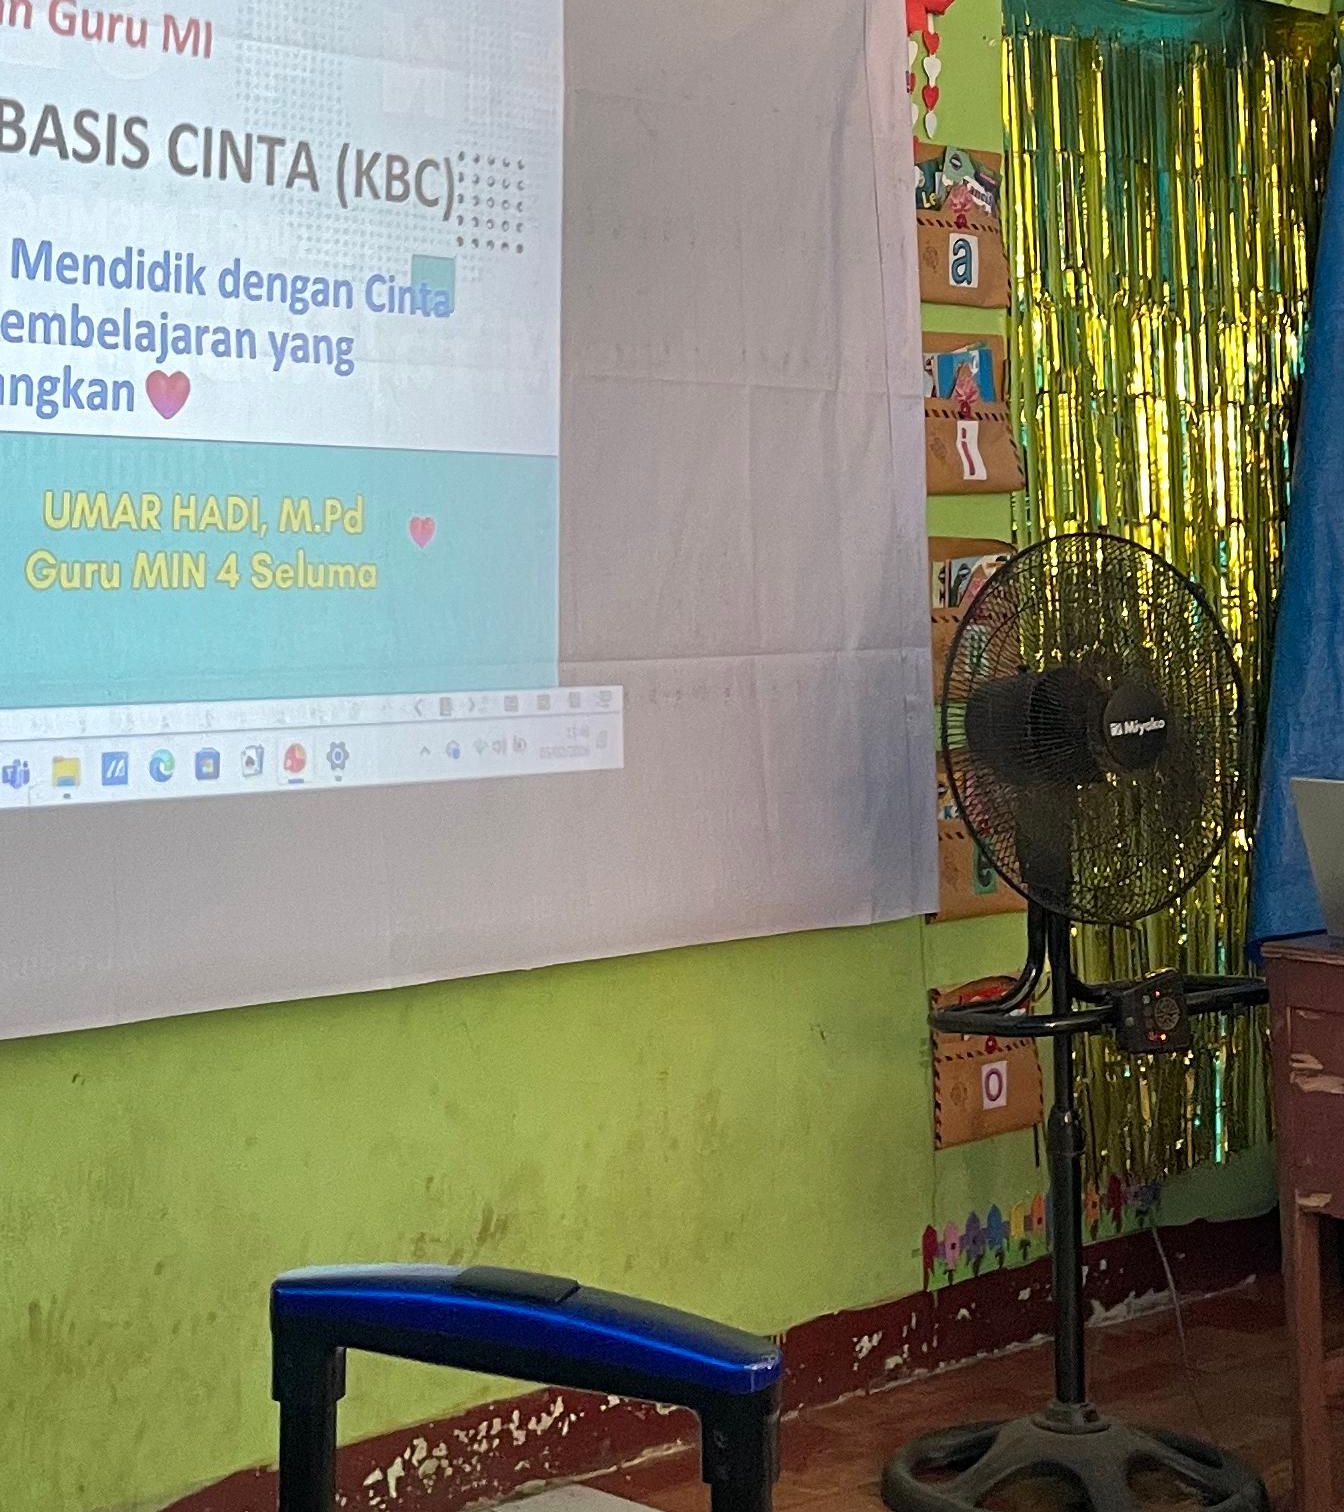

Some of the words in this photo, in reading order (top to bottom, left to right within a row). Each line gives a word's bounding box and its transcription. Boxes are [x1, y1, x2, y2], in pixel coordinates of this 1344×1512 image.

[162, 14, 213, 59] MI
[167, 122, 320, 192] CINTA
[337, 143, 456, 221] (KBC)
[11, 237, 207, 296] Mendidik
[218, 258, 354, 315] dengan
[364, 273, 454, 318] Cinta
[951, 238, 972, 286] a
[268, 330, 356, 377] yang
[43, 489, 162, 533] UMAR
[171, 494, 269, 540] HADI,
[278, 495, 364, 536] M.Pd
[24, 548, 121, 591] Guru
[131, 551, 207, 591] MIN
[217, 553, 241, 590] 4
[250, 549, 377, 591] Seluma
[1124, 716, 1166, 736] Miyako
